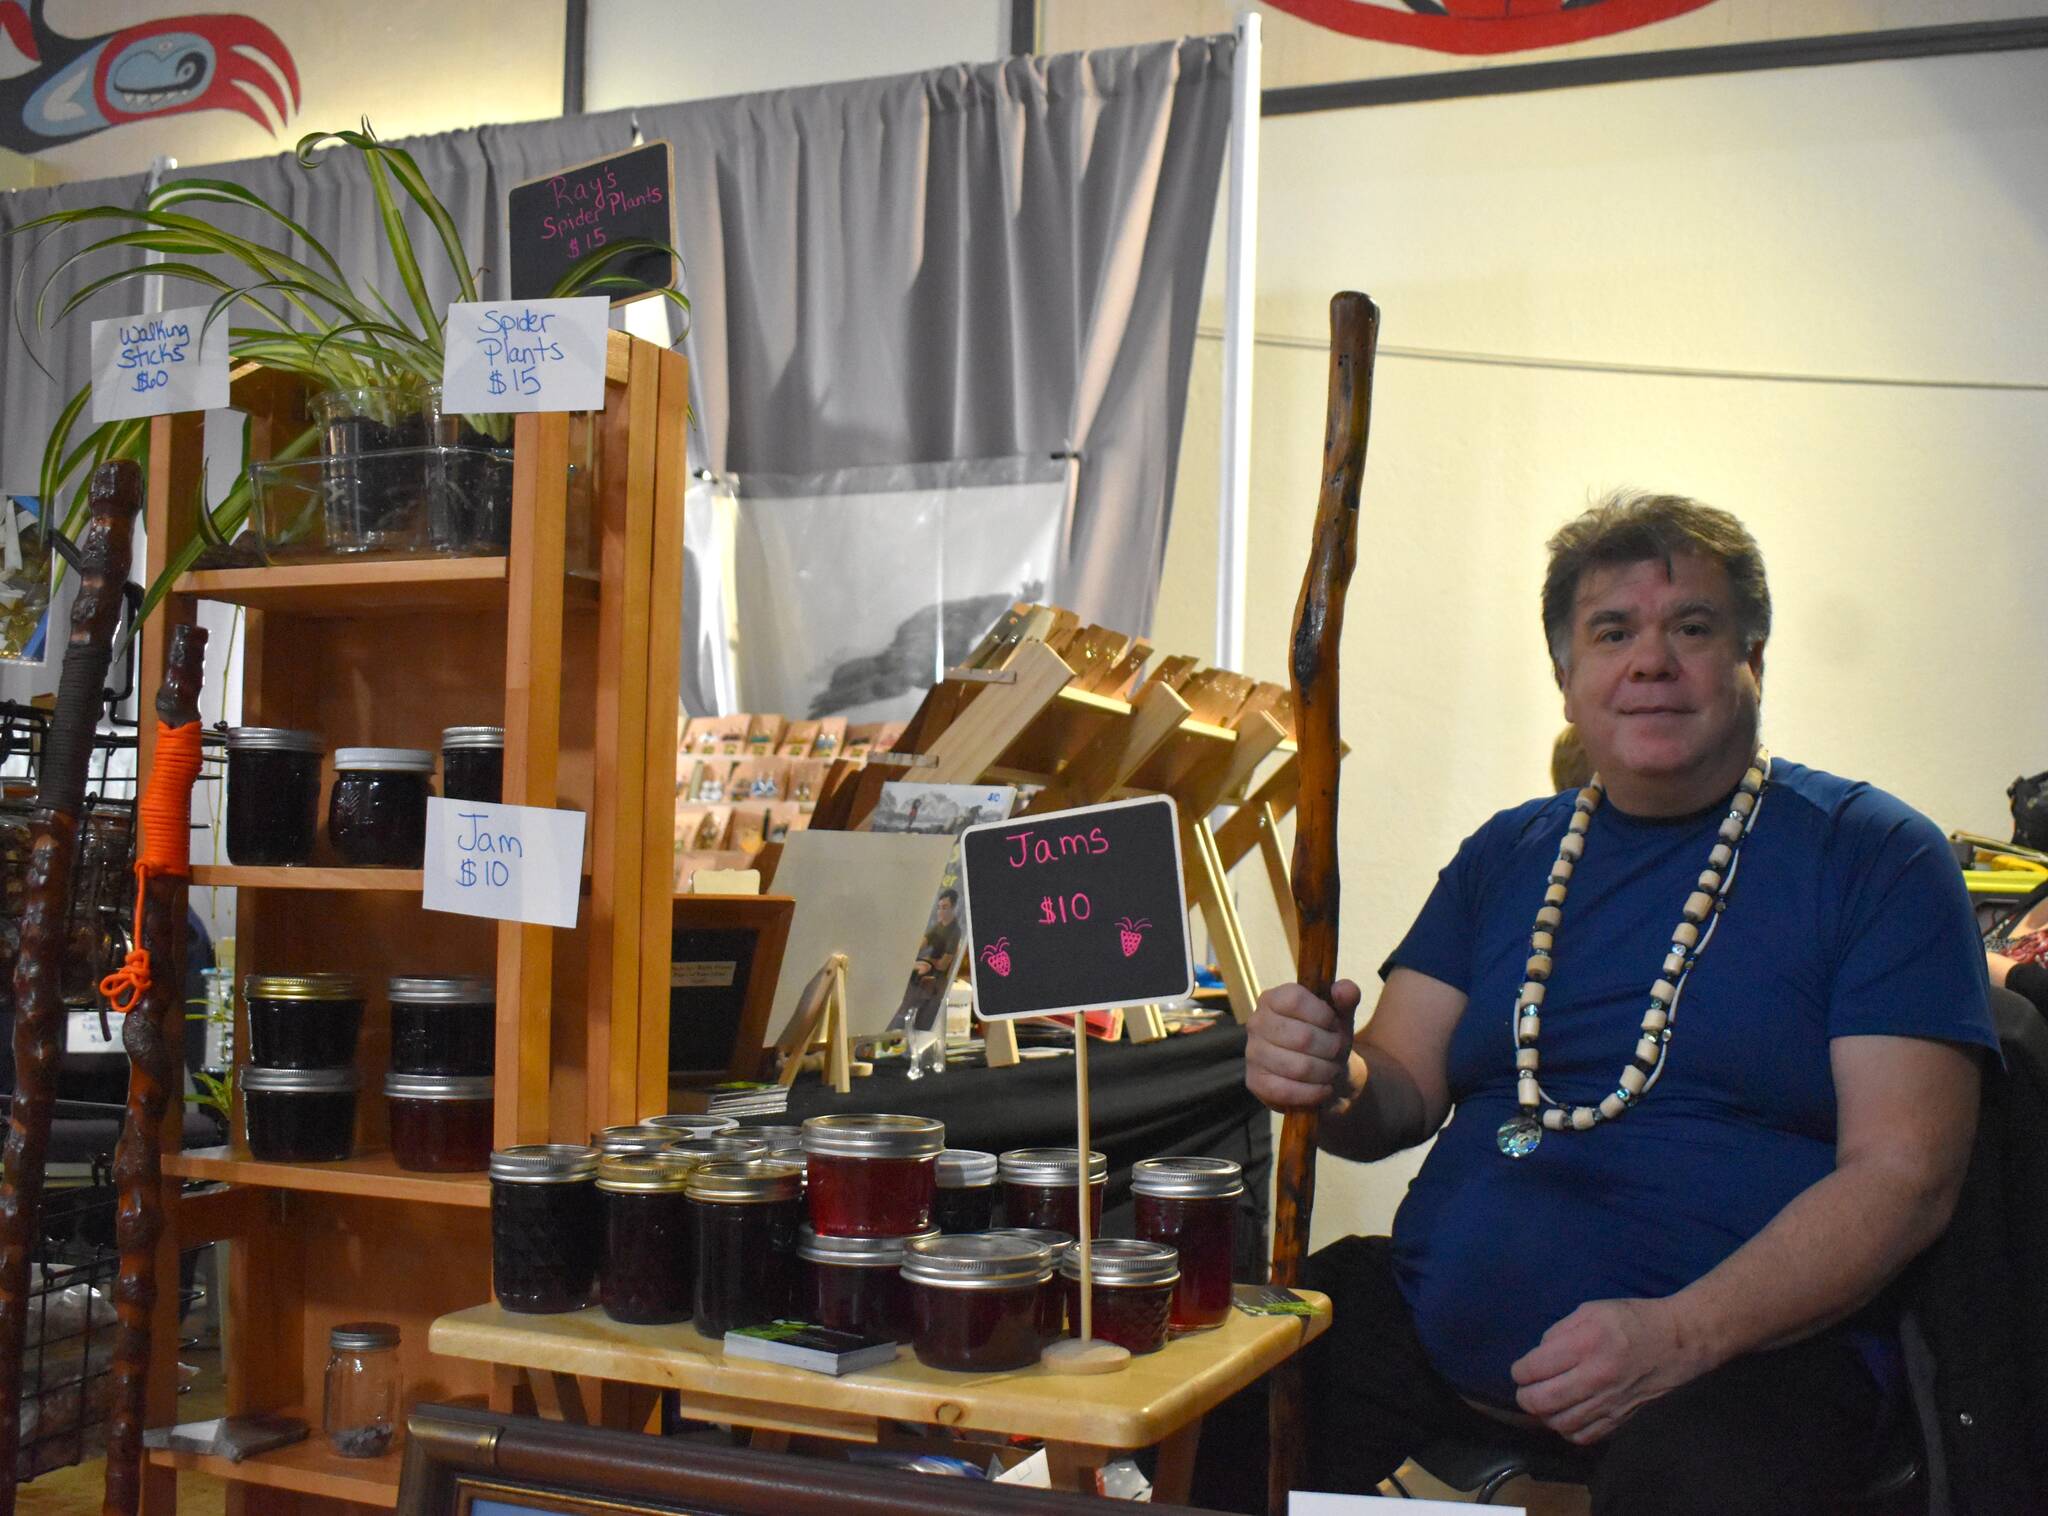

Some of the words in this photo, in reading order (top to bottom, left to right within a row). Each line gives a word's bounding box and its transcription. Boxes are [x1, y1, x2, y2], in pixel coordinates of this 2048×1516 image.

[546, 165, 618, 210] Ray's
[541, 207, 606, 240] Spider
[607, 185, 663, 216] Plants
[119, 320, 190, 347] Walking
[478, 308, 556, 339] Spider
[117, 343, 184, 369] Sticks
[476, 336, 564, 366] Plants
[487, 366, 541, 395] $15
[458, 813, 523, 858] Jam
[1005, 827, 1110, 868] Jams
[456, 858, 509, 887] $10
[1038, 893, 1090, 925] $10
